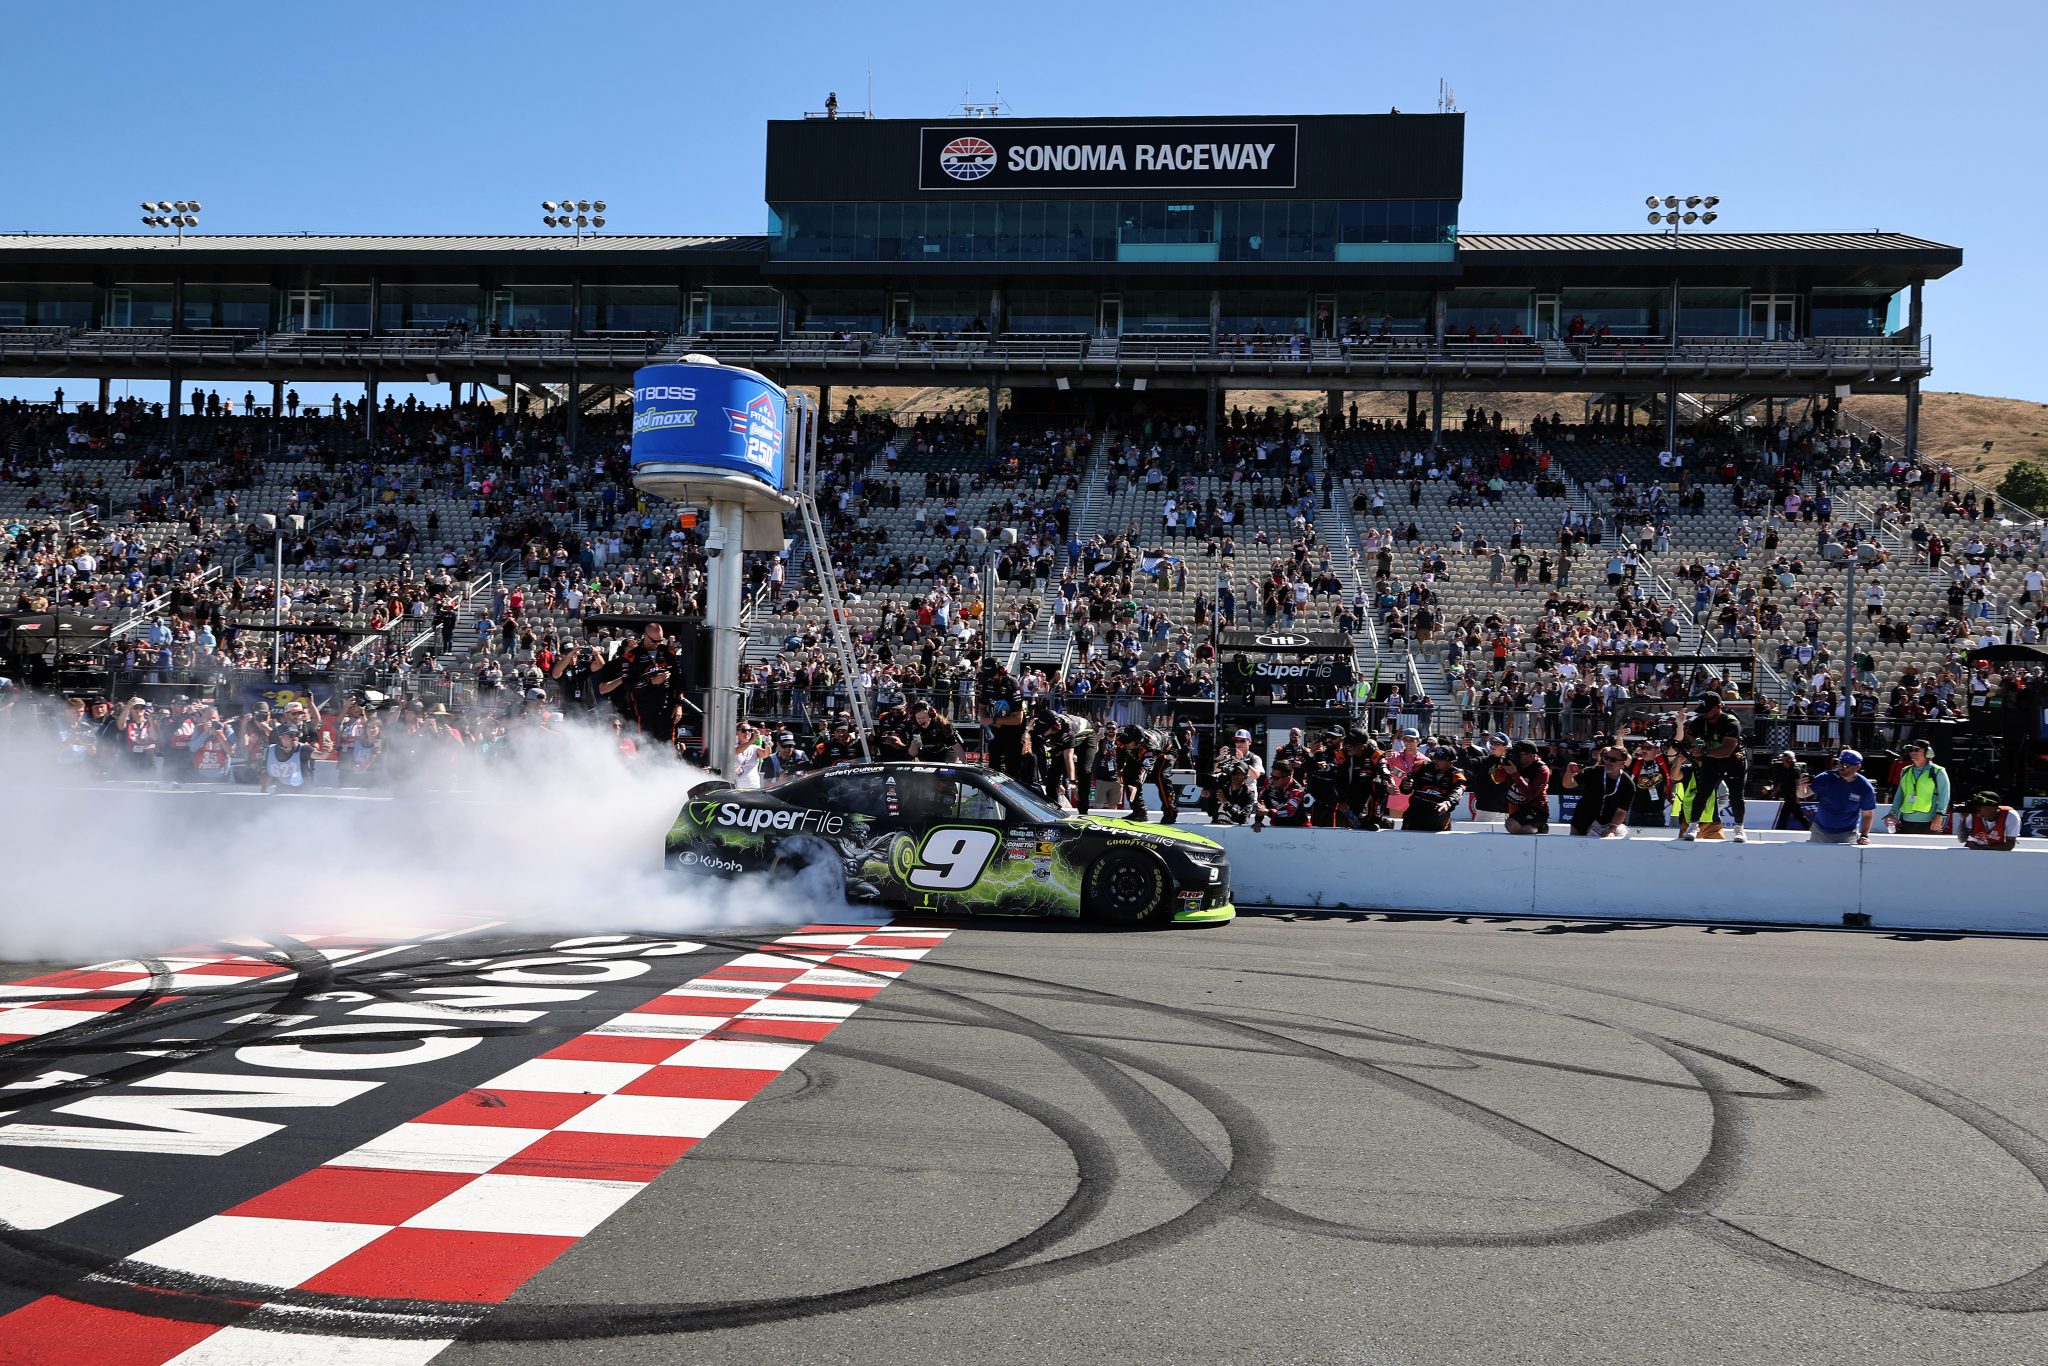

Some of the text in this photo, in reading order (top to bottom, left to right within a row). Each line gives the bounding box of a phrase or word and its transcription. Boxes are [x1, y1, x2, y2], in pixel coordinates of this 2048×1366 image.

[1007, 143, 1276, 172] SONOMA RACEWAY
[747, 437, 773, 468] 250
[1255, 663, 1332, 680] SuperFile
[823, 766, 885, 778] SafetyCulture
[1178, 784, 1204, 804] 9
[717, 802, 844, 834] SuperFile
[1106, 838, 1158, 850] GOODYEAR
[700, 854, 743, 873] Kubota
[910, 829, 997, 890] 9
[1091, 859, 1106, 886] EAGLE
[1209, 867, 1219, 881] 9
[1136, 868, 1163, 920] GOODYEAR
